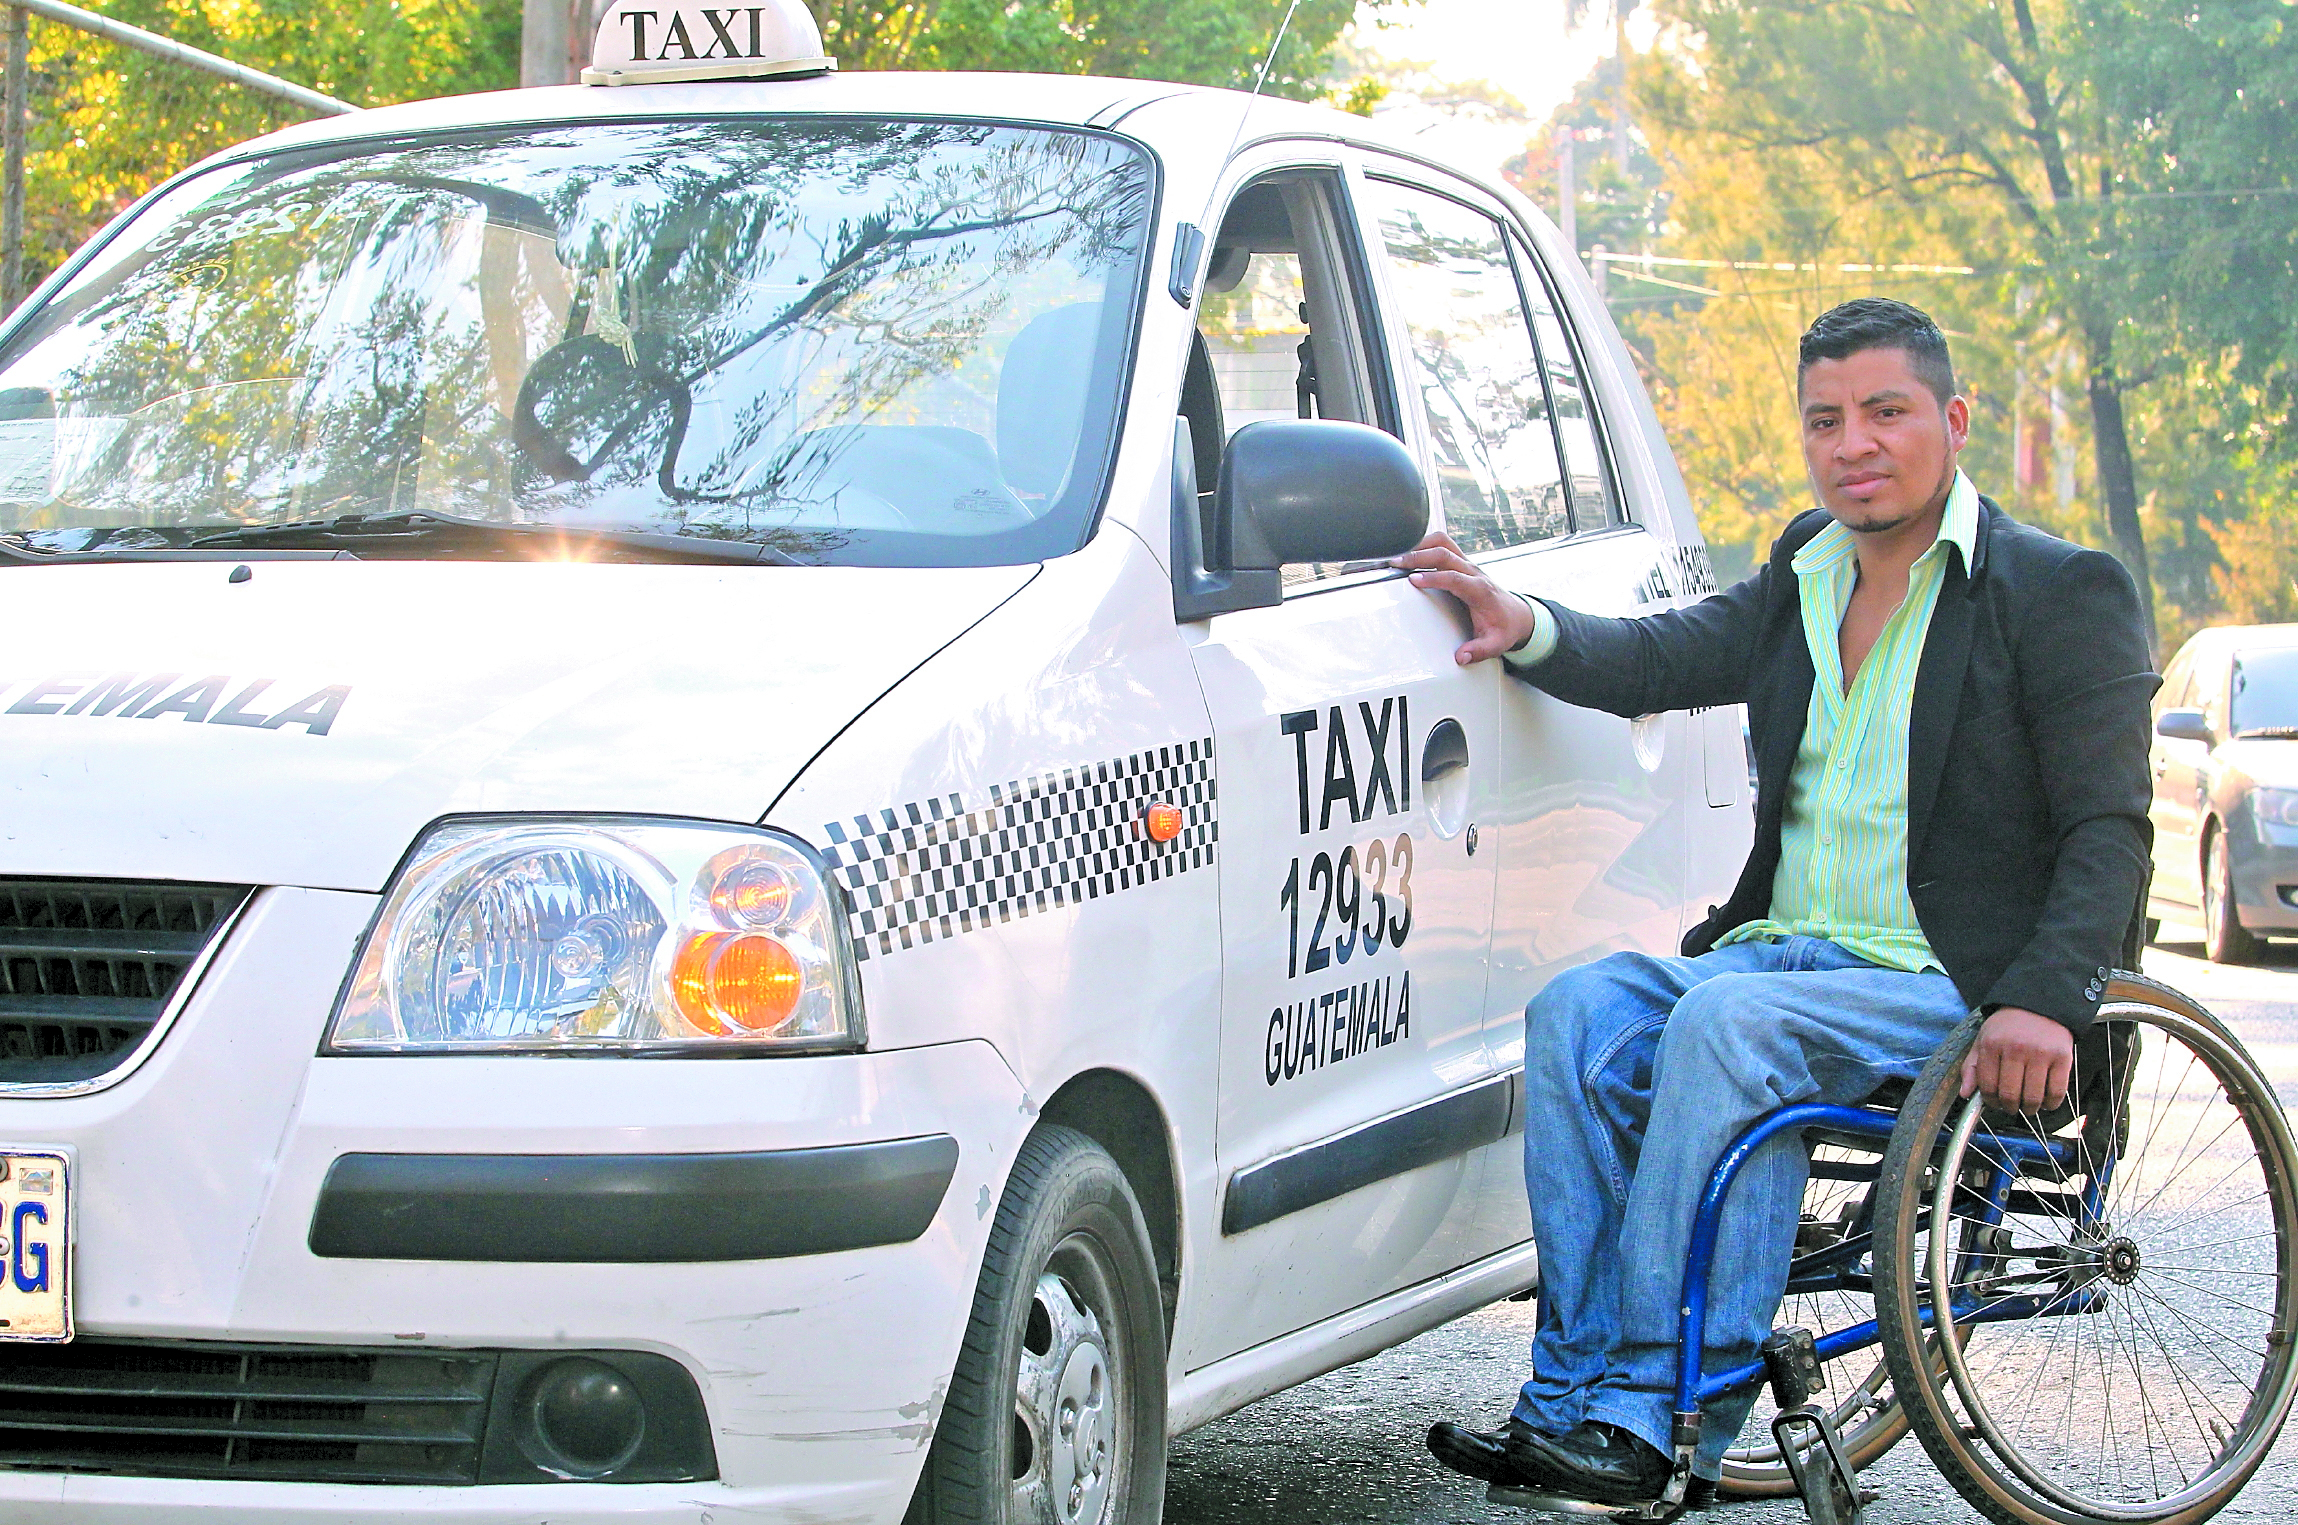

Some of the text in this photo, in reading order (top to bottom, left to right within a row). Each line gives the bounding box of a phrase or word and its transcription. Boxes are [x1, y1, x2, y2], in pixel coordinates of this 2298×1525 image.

[620, 7, 766, 62] TAXI
[0, 671, 353, 737] EMALA
[1280, 695, 1410, 835] TAXI
[1280, 832, 1413, 980] 12933
[1265, 970, 1410, 1088] GUATEMALA
[0, 1201, 49, 1292] G
